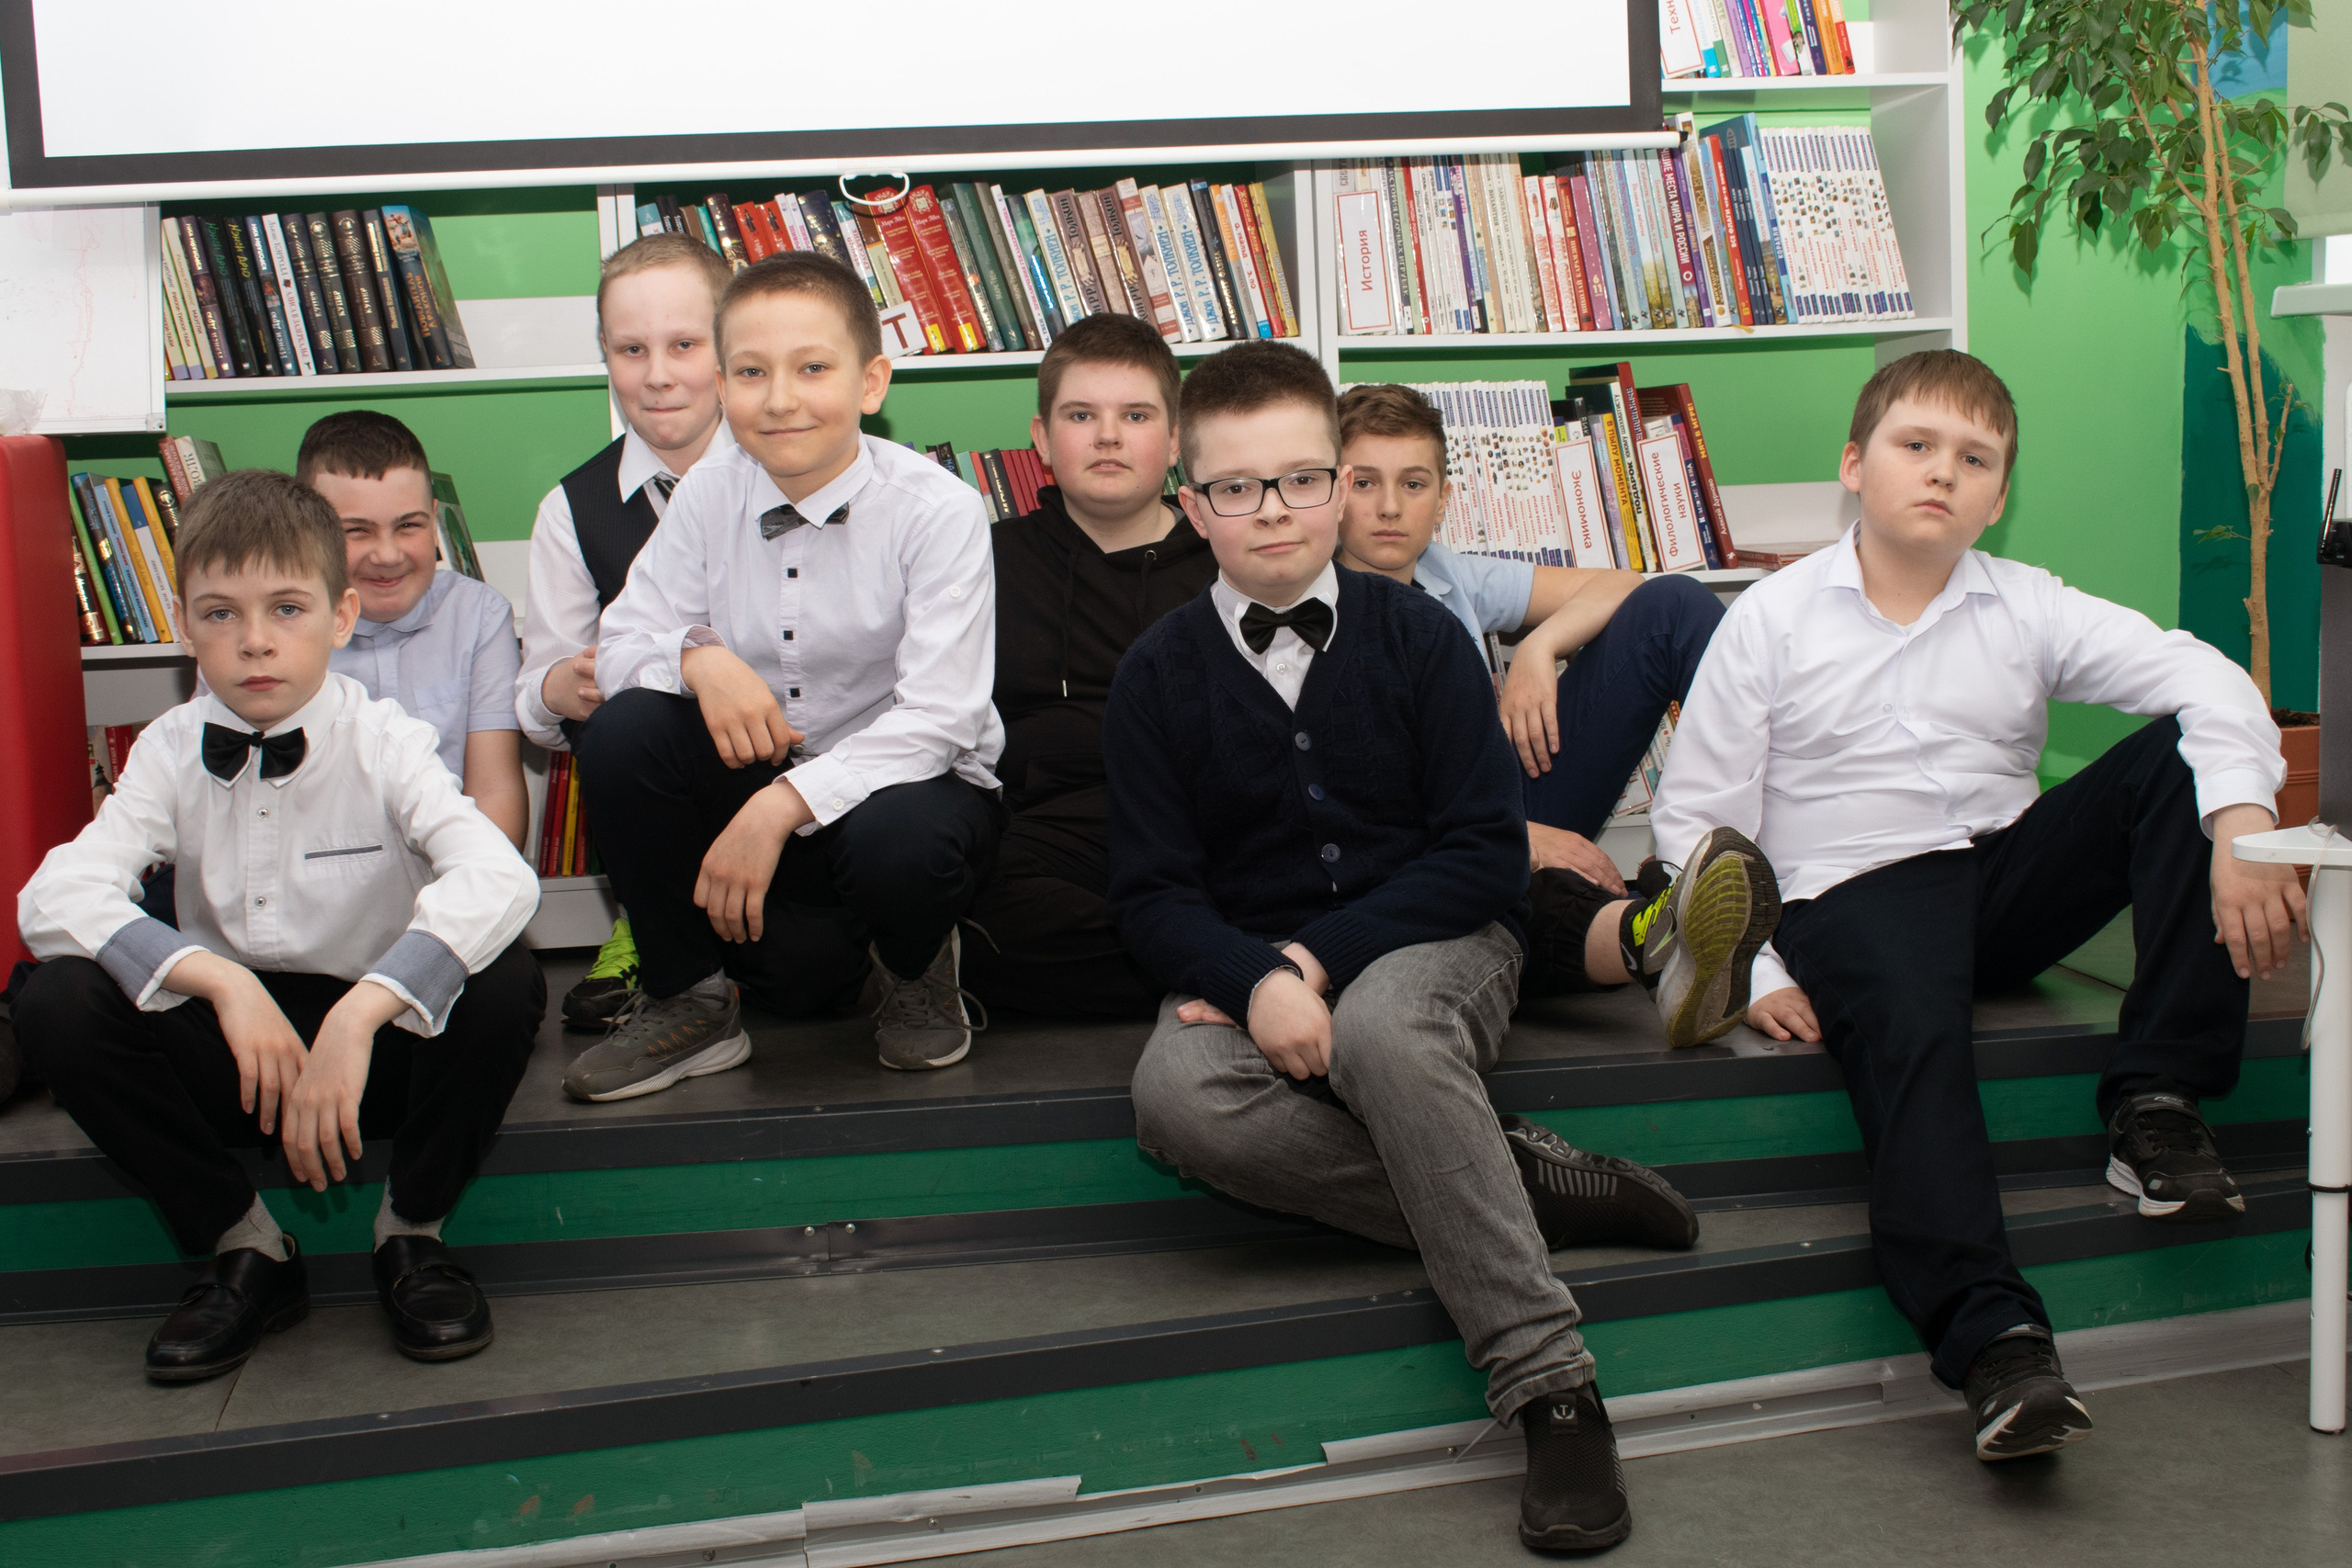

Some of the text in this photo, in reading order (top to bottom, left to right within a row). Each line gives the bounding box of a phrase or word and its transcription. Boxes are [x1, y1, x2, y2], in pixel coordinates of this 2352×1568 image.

[1661, 148, 1674, 173] ЧШИЕ
[1665, 174, 1678, 200] МЕСТА
[1239, 190, 1252, 222] Жаклин
[1669, 201, 1683, 224] МИРА
[1724, 209, 1735, 234] ФЛАГИ
[788, 224, 801, 251] РОВИЩ
[799, 224, 812, 252] РОВИЩ
[852, 228, 870, 270] КРАСАВЧИК
[1157, 231, 1179, 276] ТОЛКИЕН
[1181, 230, 1204, 276] ТОЛКИЕН
[1676, 231, 1690, 264] РОССИИ
[1728, 235, 1737, 248] ВСЕ
[1771, 227, 1784, 259] КОРАБЛИ
[1045, 233, 1068, 279] ТОЛКИЕН
[1358, 230, 1374, 292] История
[405, 271, 431, 337] ПОВЕЛИТЕЛЬ
[415, 275, 439, 328] ДРАКОНОВ
[1687, 402, 1699, 429] ИГРЕ!
[1622, 435, 1631, 458] ЮНОМУ
[1697, 438, 1707, 459] МЯЧ
[1608, 429, 1618, 457] ПЫЛУ
[1613, 459, 1628, 506] МОМЕНТА
[1628, 461, 1643, 514] ПОДАРОК
[1651, 451, 1679, 558] Филологические
[1673, 482, 1688, 519] науки
[1571, 469, 1592, 549] Экономика
[1708, 478, 1728, 536] Алексей Дурново
